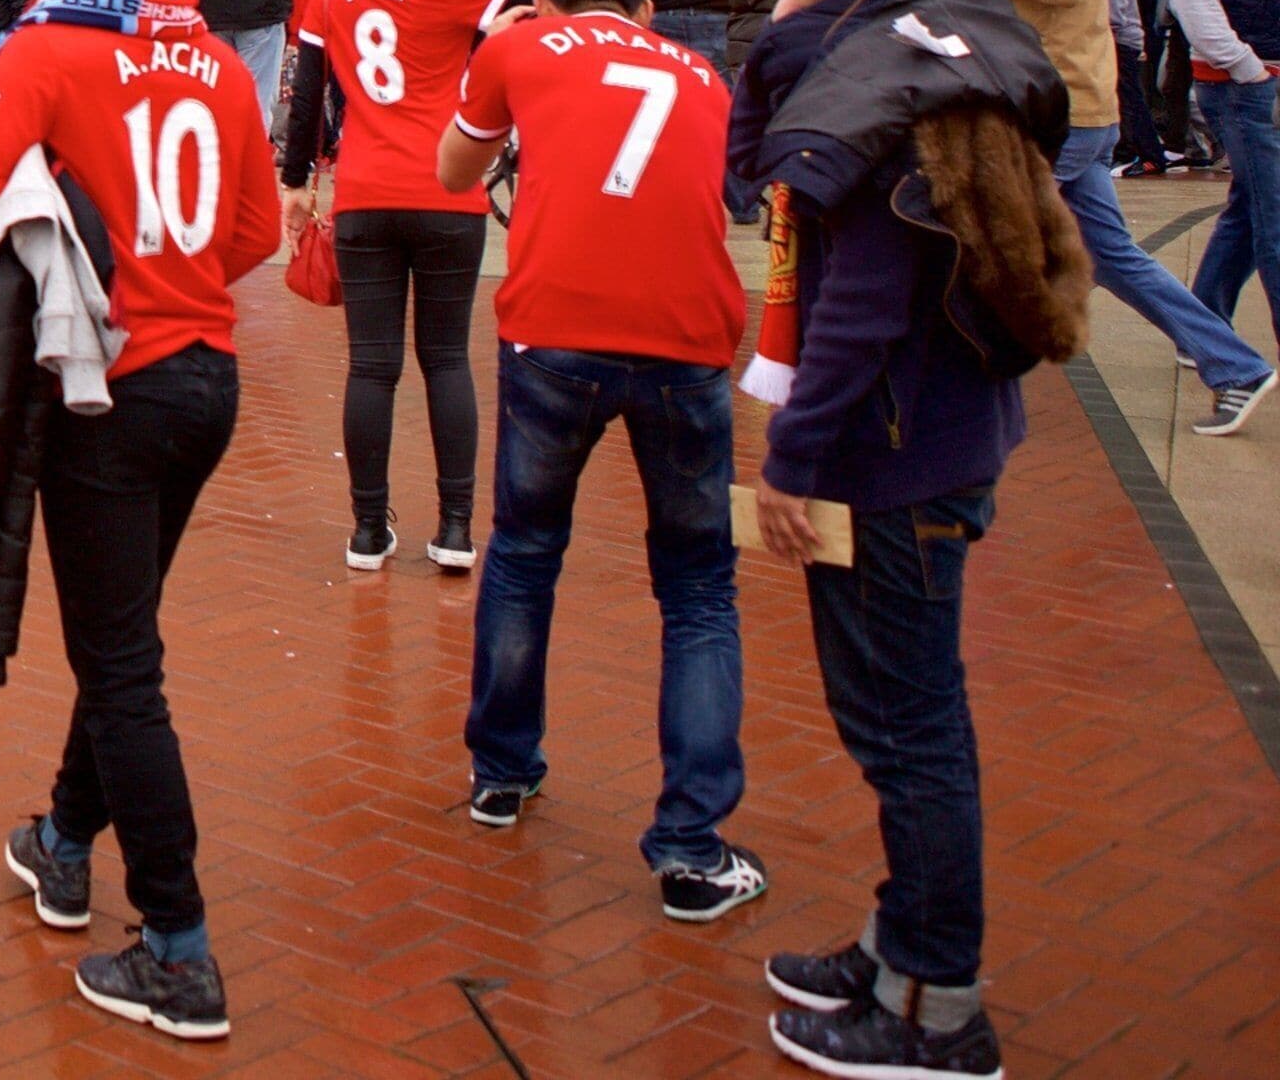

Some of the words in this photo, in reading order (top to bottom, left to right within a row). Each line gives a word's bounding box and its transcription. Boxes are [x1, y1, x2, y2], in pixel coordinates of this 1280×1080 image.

[354, 8, 405, 105] 8
[540, 26, 586, 55] DI
[590, 27, 711, 87] MARIA
[122, 96, 221, 258] 10
[601, 61, 678, 199] 7
